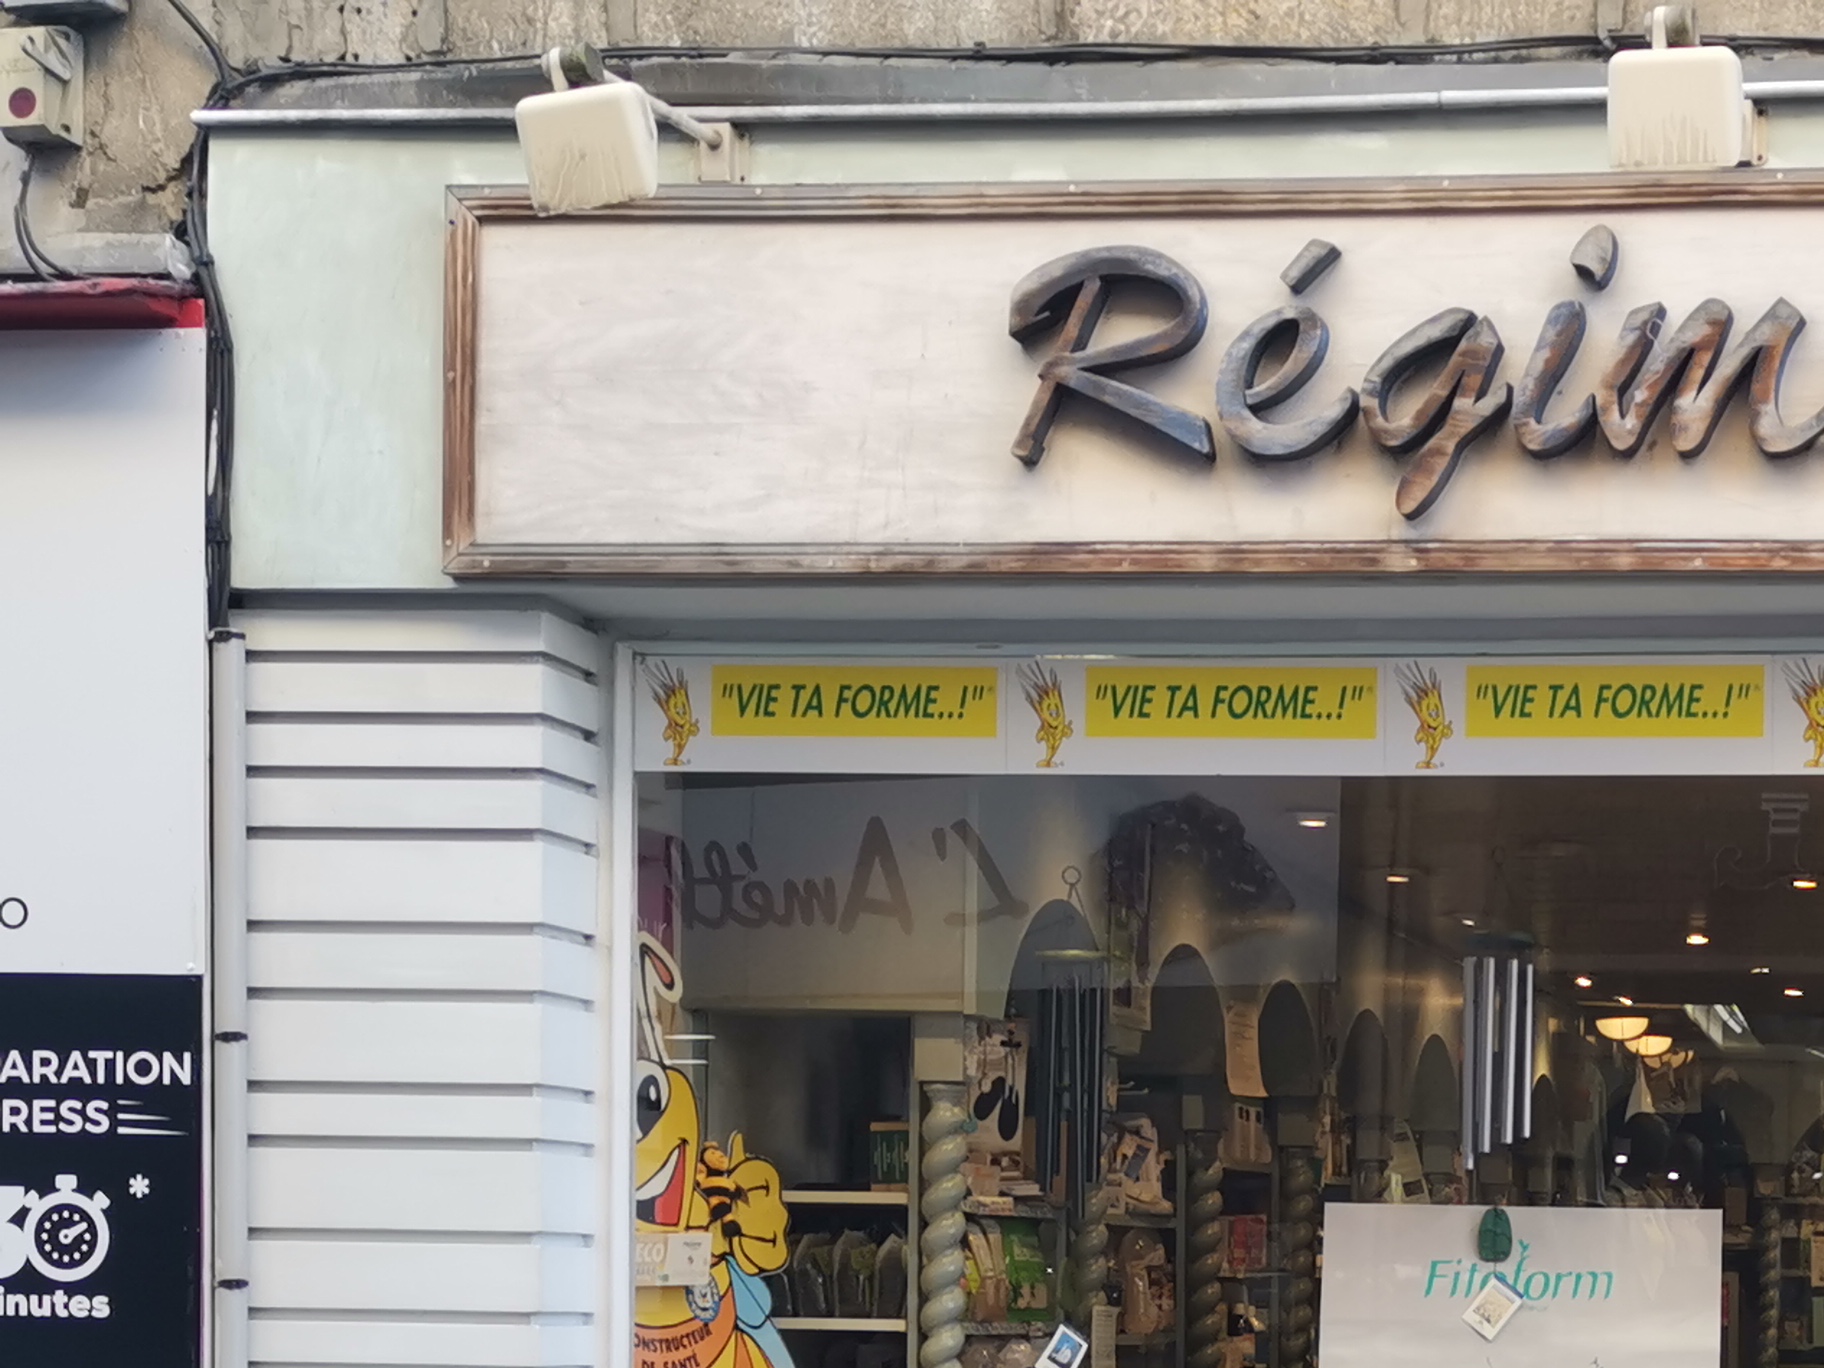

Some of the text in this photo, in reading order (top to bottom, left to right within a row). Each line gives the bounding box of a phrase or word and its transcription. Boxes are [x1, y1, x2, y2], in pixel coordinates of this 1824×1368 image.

[791, 683, 826, 719] TA
[1165, 686, 1202, 720] TA
[1546, 684, 1582, 719] TA
